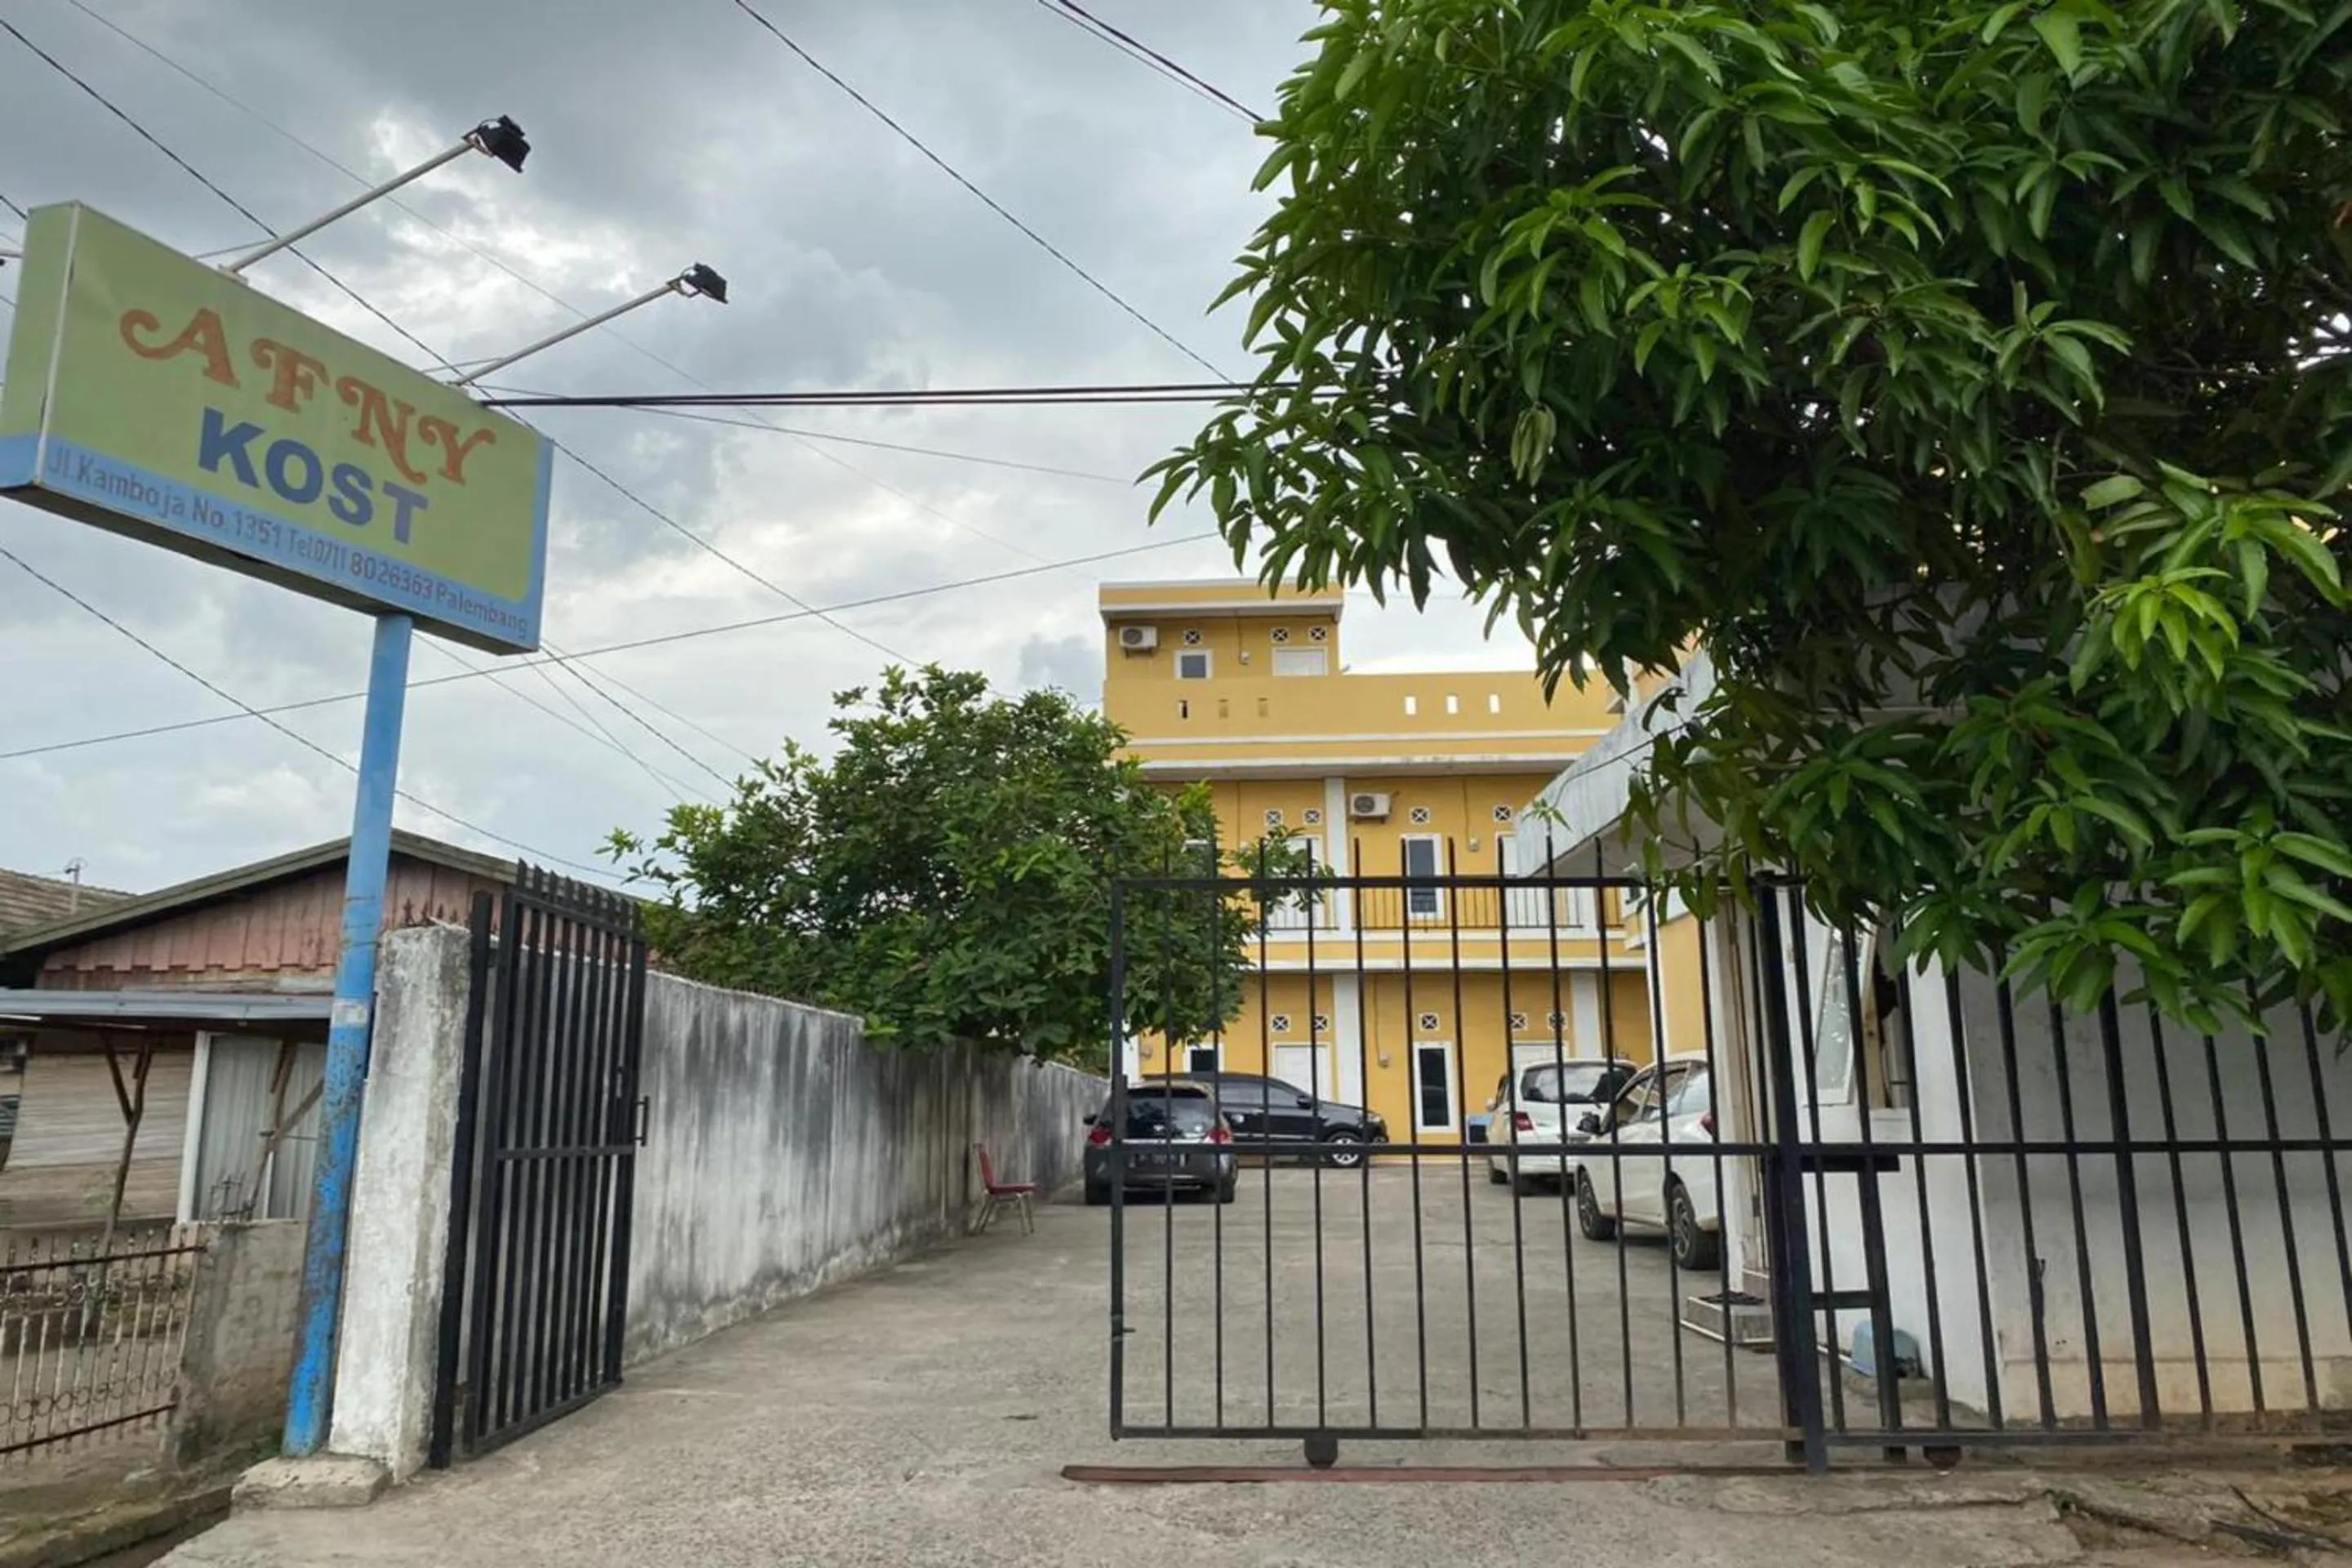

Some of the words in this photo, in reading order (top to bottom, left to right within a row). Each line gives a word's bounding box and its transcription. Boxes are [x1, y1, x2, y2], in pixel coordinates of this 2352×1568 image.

[120, 308, 496, 485] AFNY
[76, 453, 185, 519] Kamboja
[233, 508, 283, 550] 1351
[198, 407, 429, 545] KOST
